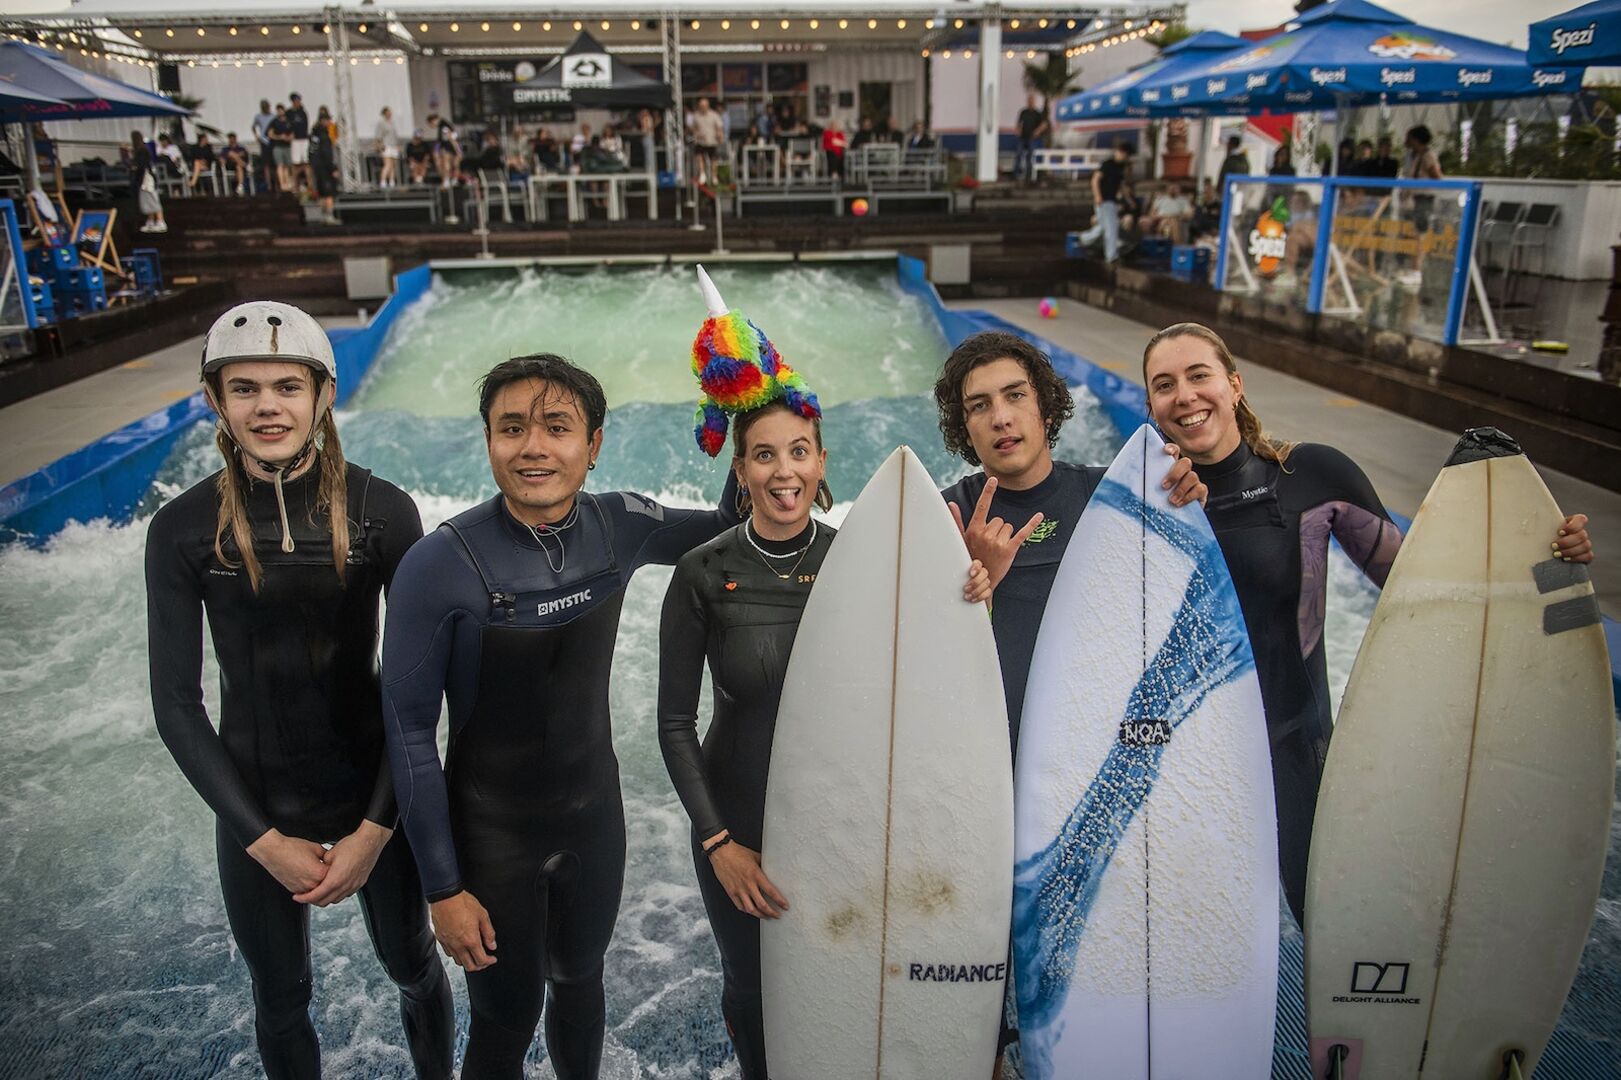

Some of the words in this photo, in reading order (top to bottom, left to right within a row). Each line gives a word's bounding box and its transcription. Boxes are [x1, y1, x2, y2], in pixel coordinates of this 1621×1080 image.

[1551, 23, 1596, 55] Spezi
[1311, 67, 1346, 87] Spezi
[1381, 67, 1415, 87] Spezi
[1457, 68, 1492, 87] Spezi
[1532, 70, 1566, 87] Spezi
[1241, 486, 1269, 500] Mystic
[548, 588, 592, 614] MYSTIC
[909, 962, 1005, 983] RADIANCE
[1332, 995, 1372, 1004] DELIGHT
[1373, 996, 1421, 1005] ALLIANCE
